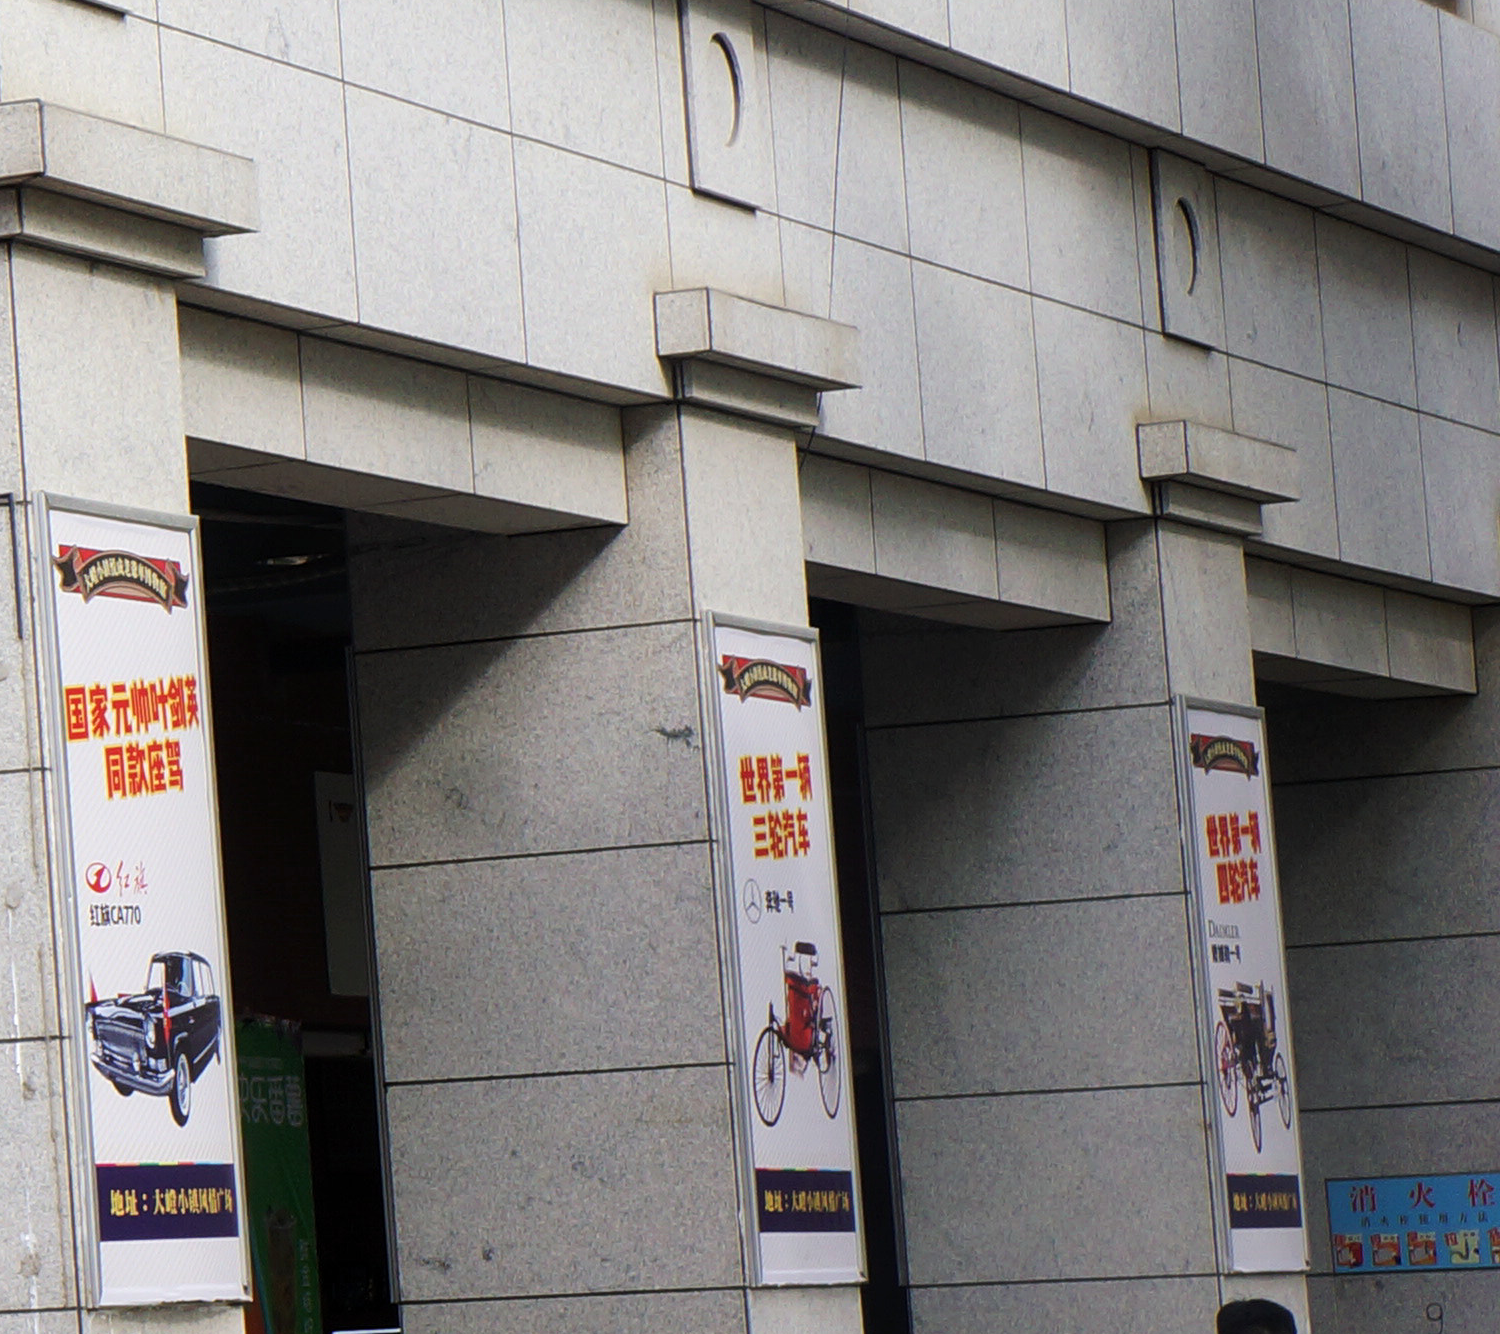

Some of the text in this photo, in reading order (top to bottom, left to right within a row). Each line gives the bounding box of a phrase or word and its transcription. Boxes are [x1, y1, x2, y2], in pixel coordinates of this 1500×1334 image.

[65, 675, 199, 742] 国家元帅叶剑英
[103, 739, 184, 800] 同款座驾
[738, 751, 813, 805] 世界第一辆
[752, 807, 811, 860] 三轮汽车
[1205, 809, 1262, 858] 世界第一辆
[1215, 857, 1261, 905] 四轮汽车
[90, 903, 142, 927] 红旗CA770
[1349, 1179, 1496, 1214] 消火栓
